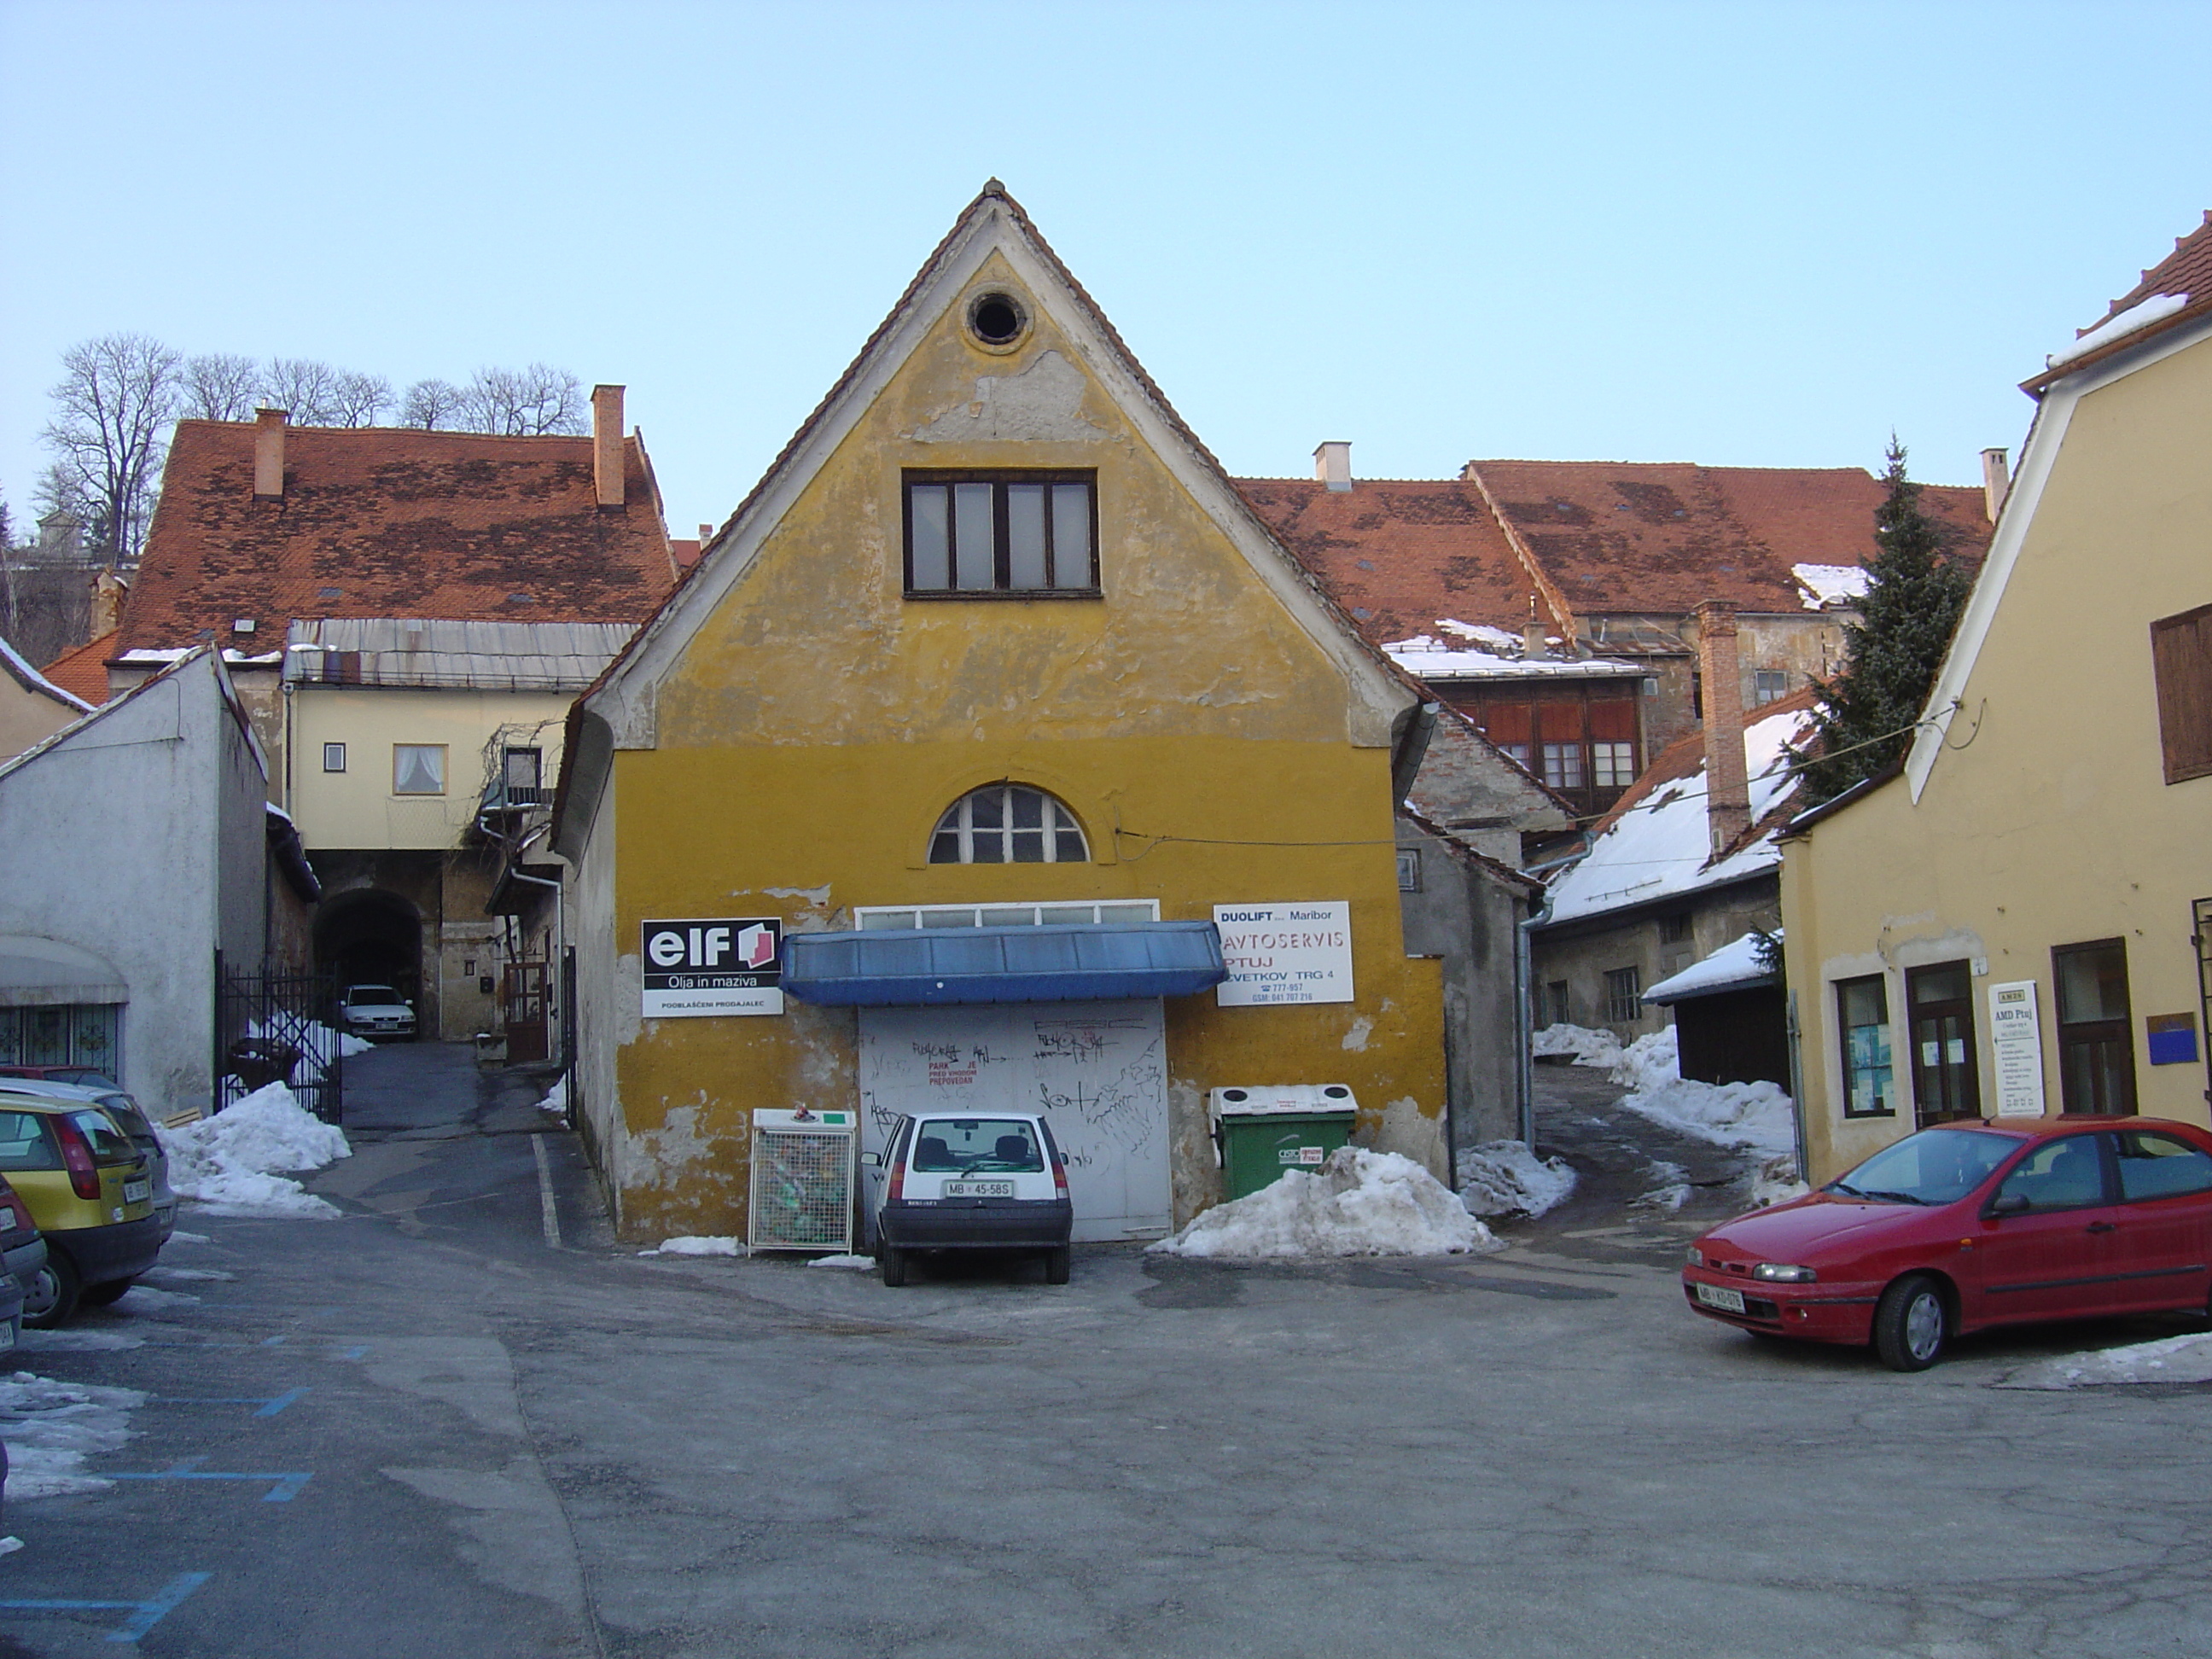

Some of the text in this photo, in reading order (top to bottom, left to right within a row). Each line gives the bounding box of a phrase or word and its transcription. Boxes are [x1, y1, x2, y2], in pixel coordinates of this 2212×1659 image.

[1221, 911, 1272, 922] DUOLIFT
[1290, 910, 1332, 920] Maribor
[1223, 931, 1344, 950] AVTOSERVIS
[649, 928, 731, 967] elf
[1223, 957, 1273, 969] PTUJ
[1295, 970, 1324, 980] TRG
[668, 974, 757, 989] Olja in maziva
[1995, 1008, 2032, 1021] AMD Ptuj
[949, 1184, 964, 1194] MB
